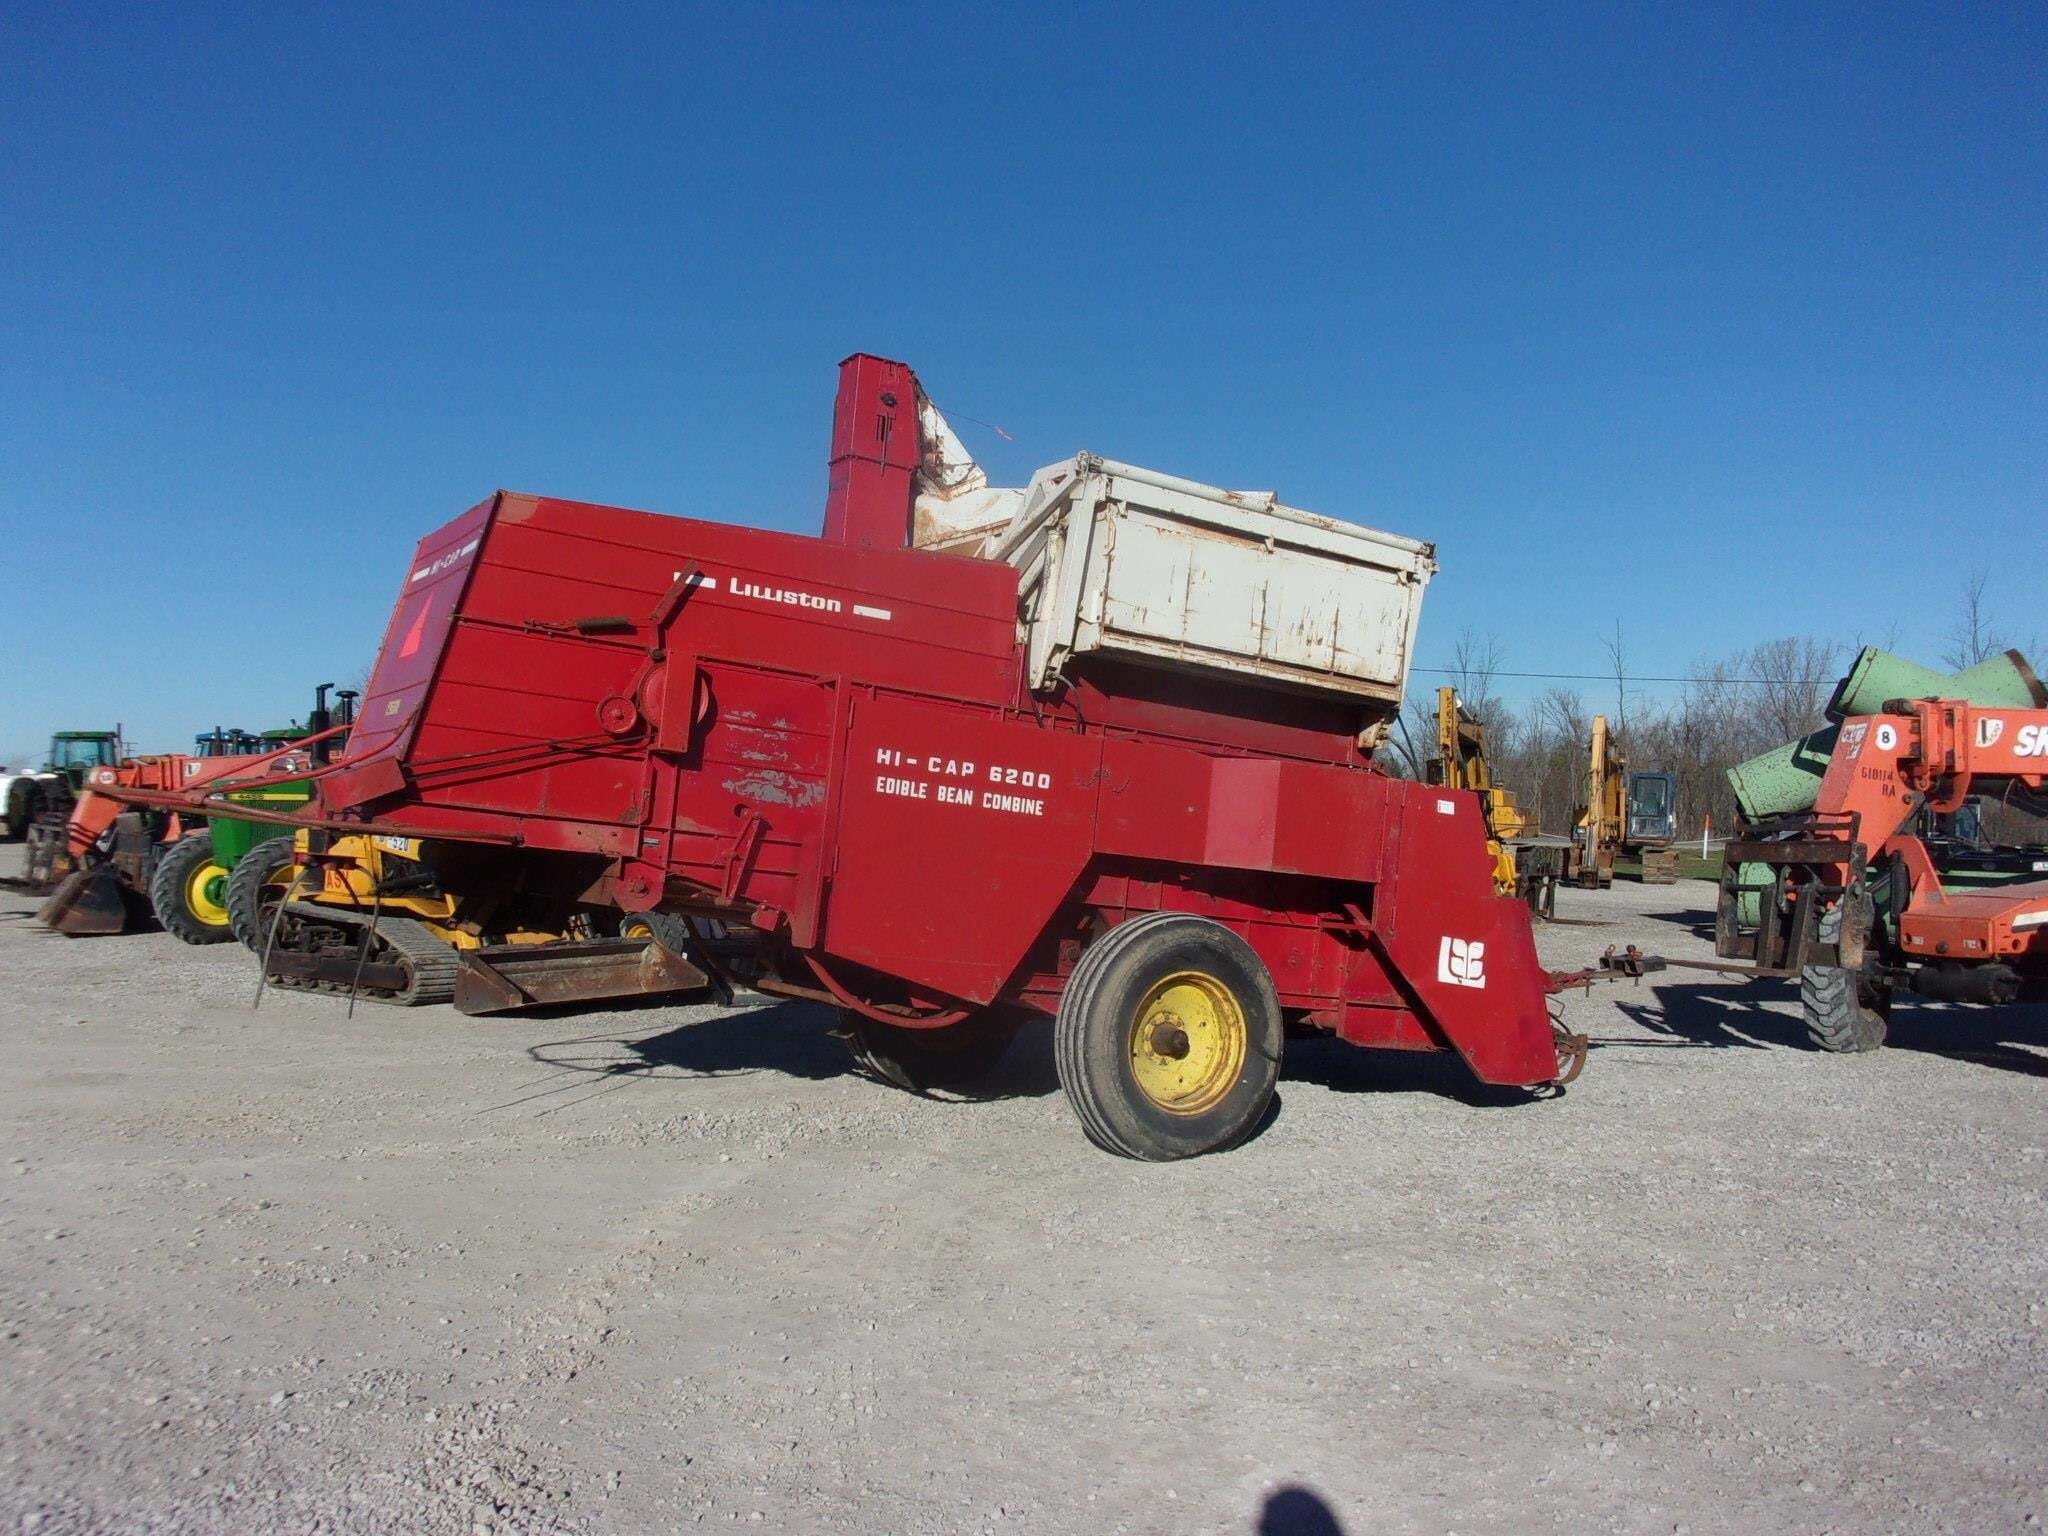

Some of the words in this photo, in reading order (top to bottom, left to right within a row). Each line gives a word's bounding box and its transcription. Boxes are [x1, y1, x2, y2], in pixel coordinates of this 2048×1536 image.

[1882, 731, 1890, 744] 8
[989, 766, 1051, 789] 6200
[876, 776, 928, 799] EDIBLE
[937, 785, 974, 806] BEAN
[982, 792, 1045, 816] COMBINE
